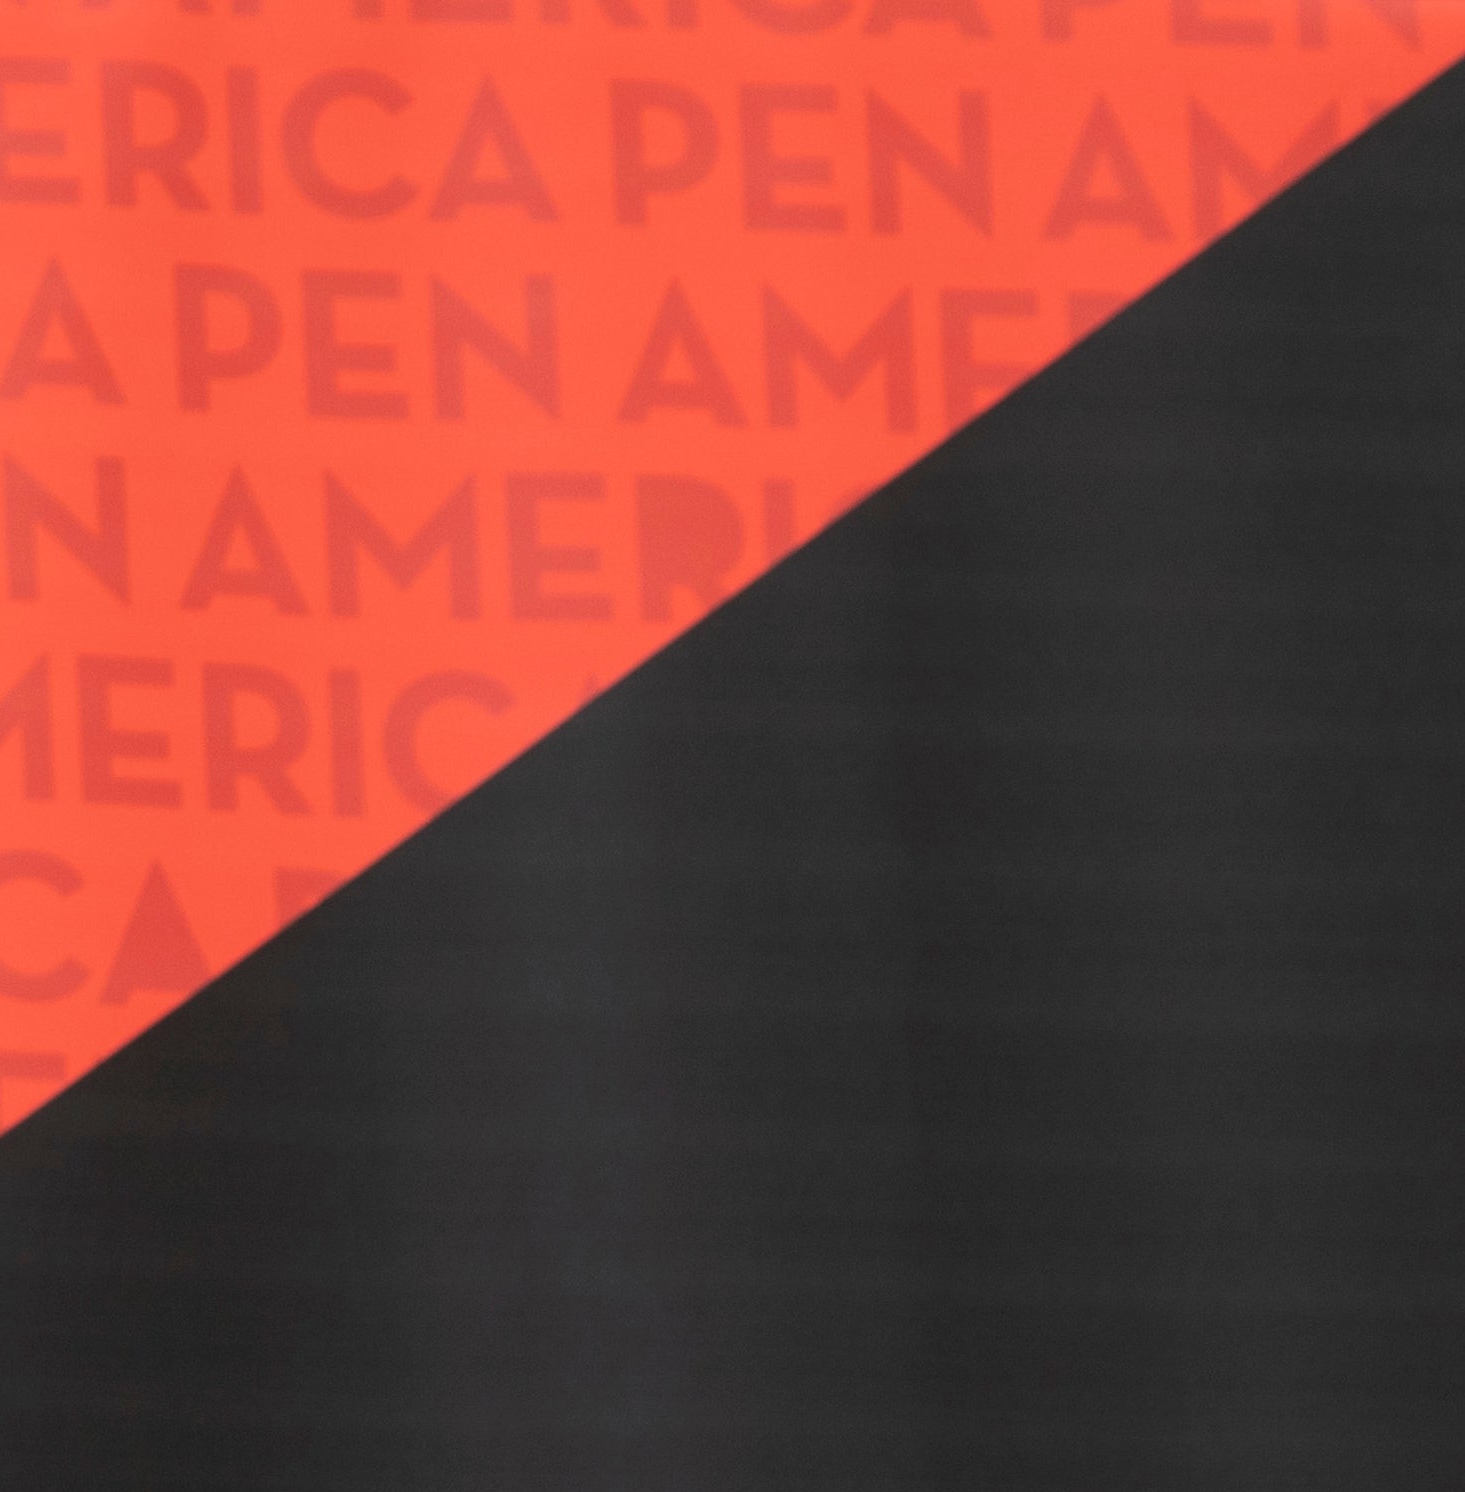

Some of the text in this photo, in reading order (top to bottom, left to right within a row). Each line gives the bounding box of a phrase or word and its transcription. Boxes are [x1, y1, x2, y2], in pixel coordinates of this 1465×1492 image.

[607, 78, 995, 240] PEN
[1041, 94, 1395, 245] AM
[171, 261, 560, 423] PEN
[178, 464, 865, 624] AMERI
